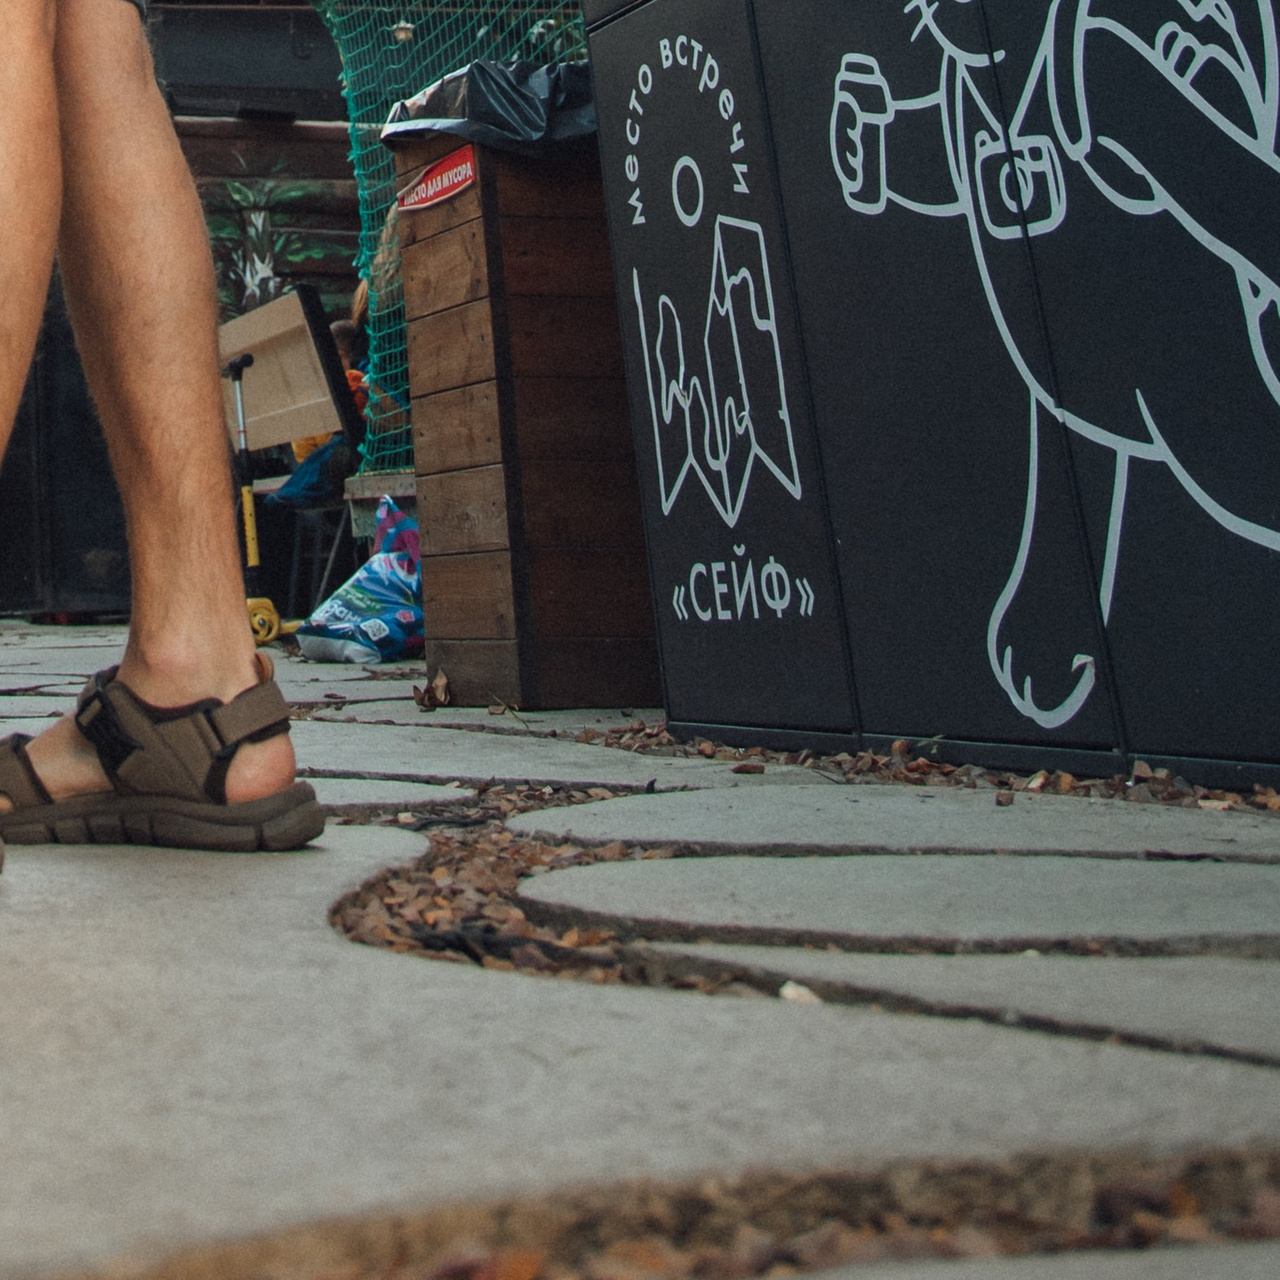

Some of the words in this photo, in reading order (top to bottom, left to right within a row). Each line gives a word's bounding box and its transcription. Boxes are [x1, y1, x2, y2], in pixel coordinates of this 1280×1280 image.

[427, 176, 442, 197] ДЛЯ
[442, 162, 473, 188] МУСОРА
[672, 543, 815, 622] «СЕЙФ»
